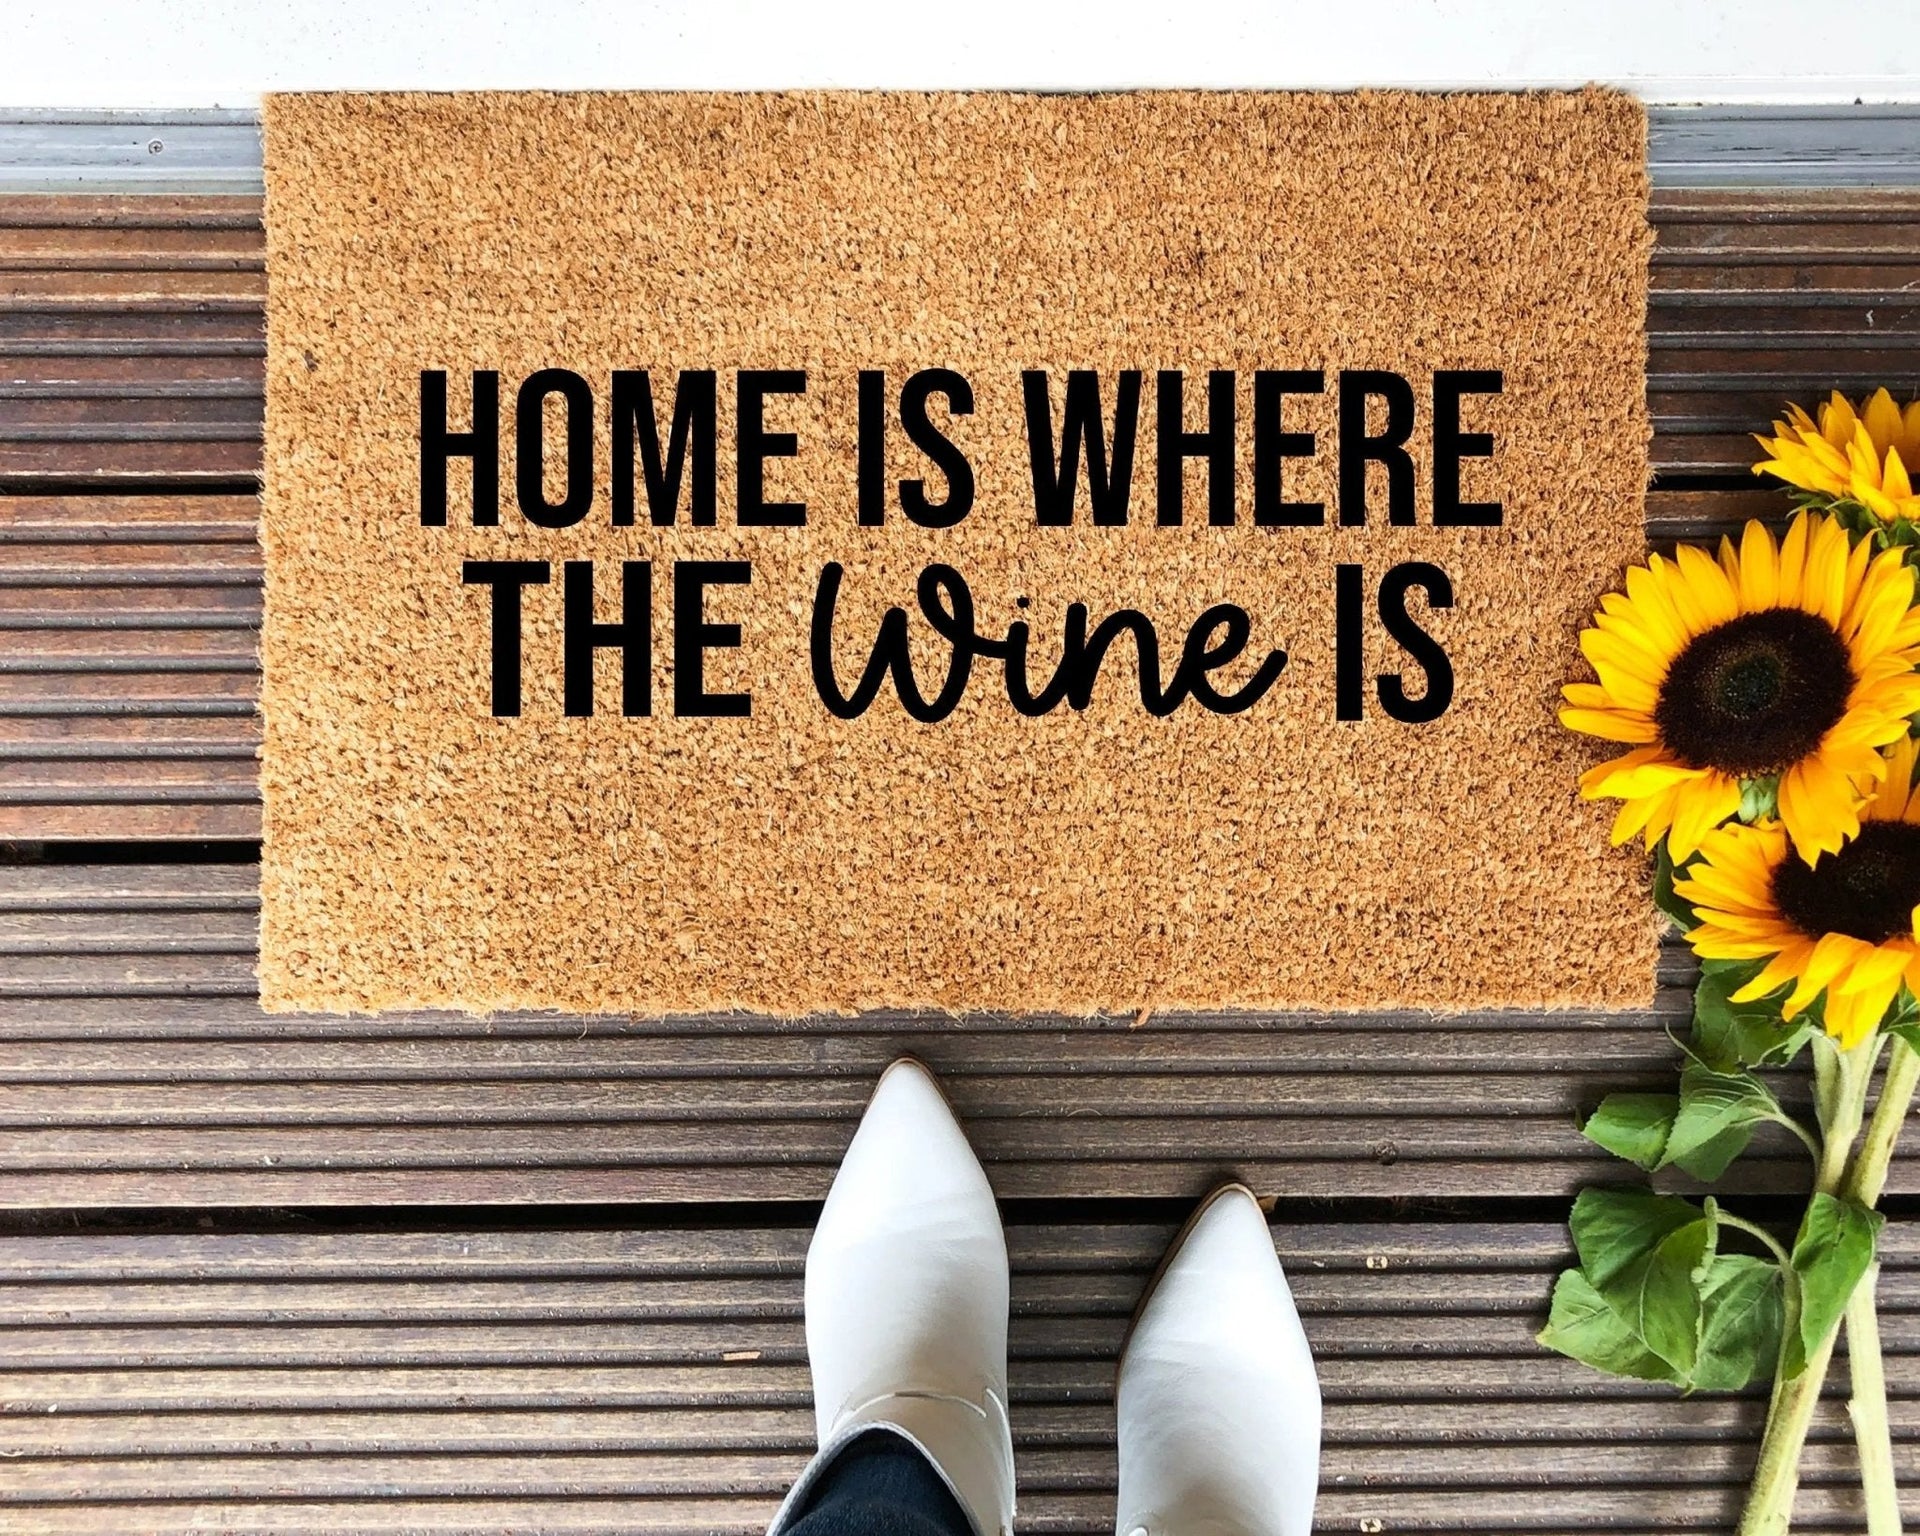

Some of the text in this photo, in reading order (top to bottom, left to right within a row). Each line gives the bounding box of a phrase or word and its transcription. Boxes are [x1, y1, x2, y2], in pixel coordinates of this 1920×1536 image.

[421, 369, 1504, 530] HOME IS WHERE
[463, 562, 1455, 725] THE Wine IS
